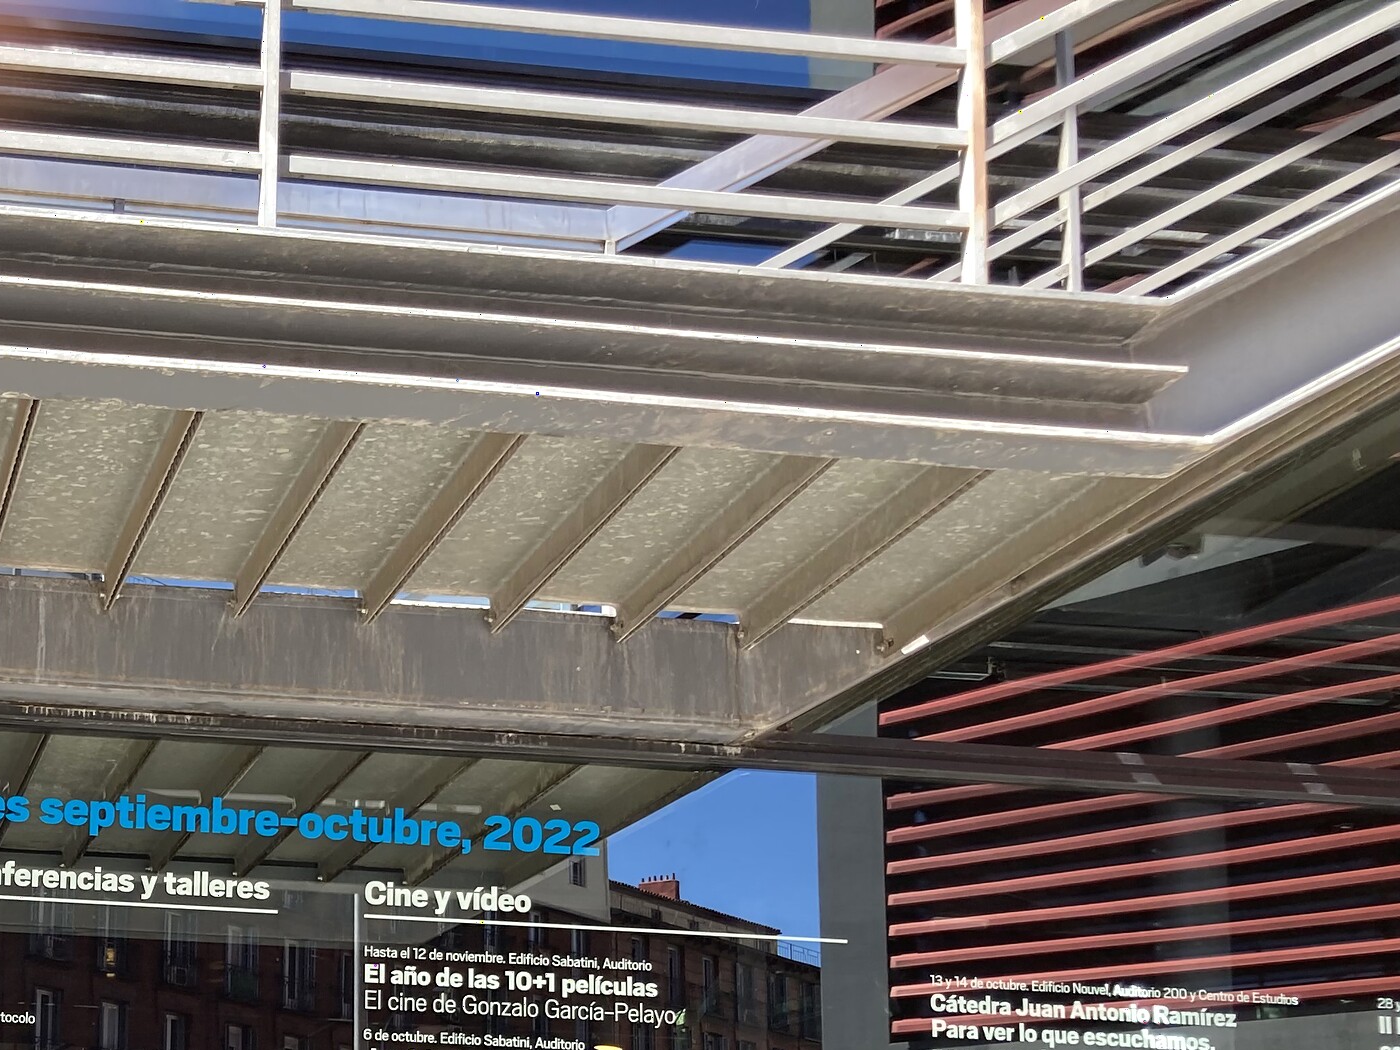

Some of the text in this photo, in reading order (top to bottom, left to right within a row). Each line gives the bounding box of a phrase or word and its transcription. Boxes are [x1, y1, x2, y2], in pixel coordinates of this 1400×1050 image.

[484, 813, 599, 854] 2022
[141, 876, 157, 898] y
[164, 871, 269, 899] talleres
[365, 881, 531, 913] Cine y vídeo
[365, 943, 652, 972] Hasta el 12 de noviembre. Edificio Sabatini, Auditorio
[365, 964, 657, 998] El año de las 10+1 películas
[931, 993, 1238, 1028] Cátedra Juan Antonio Ramírez
